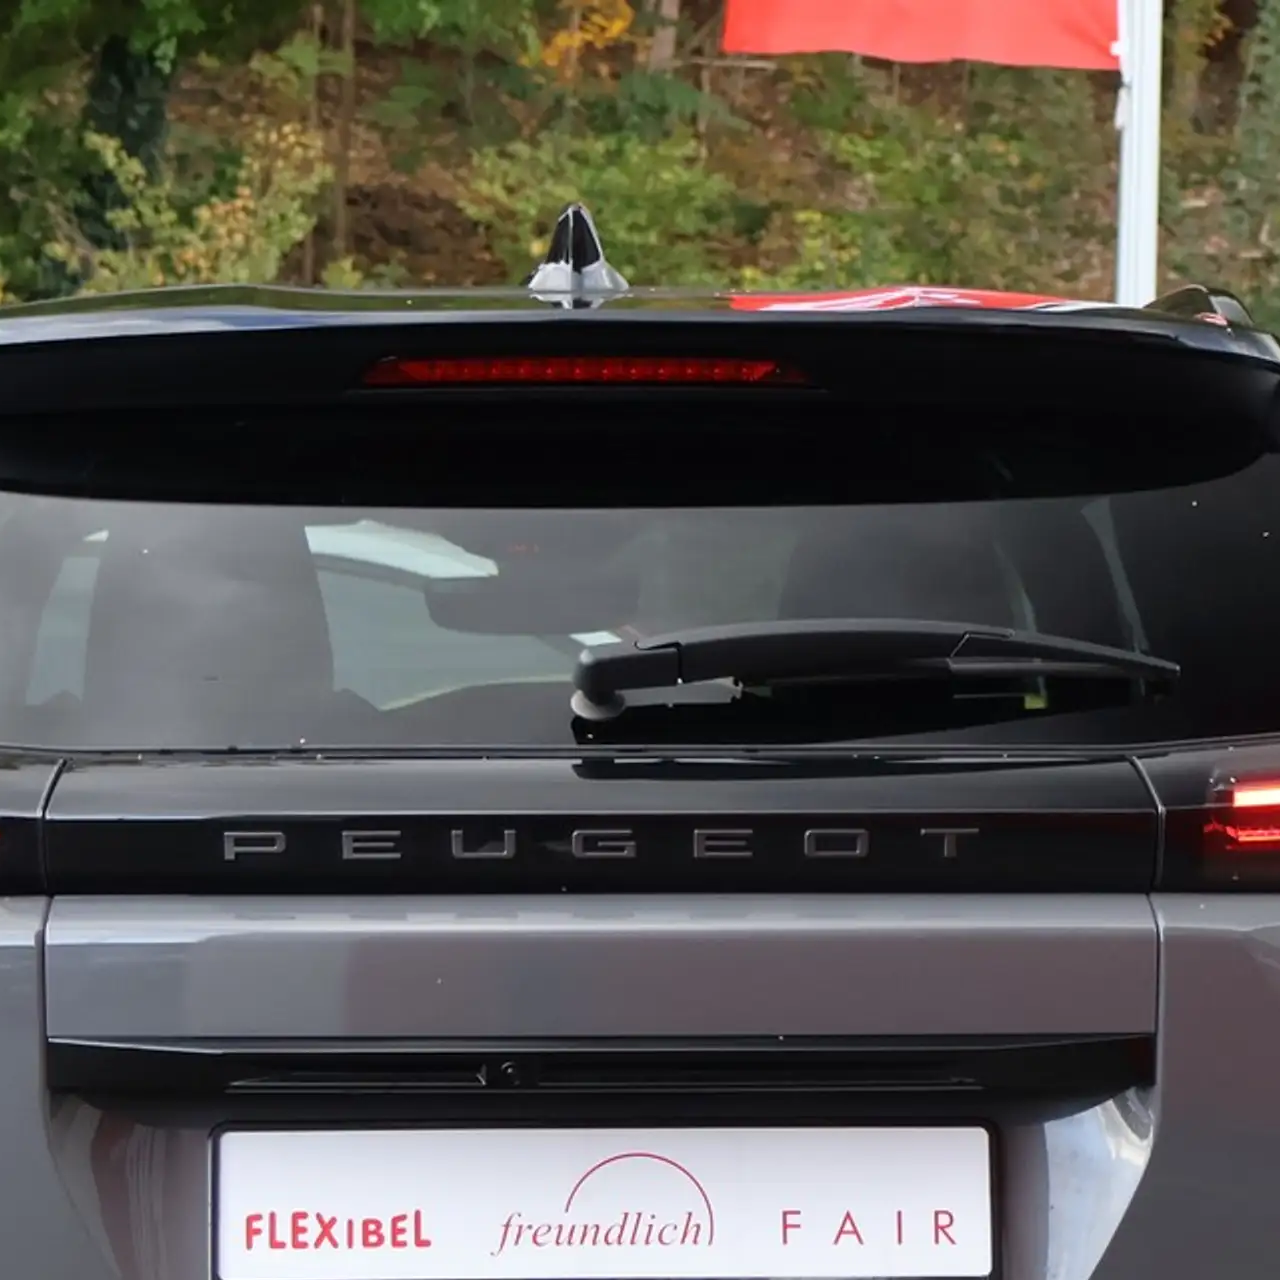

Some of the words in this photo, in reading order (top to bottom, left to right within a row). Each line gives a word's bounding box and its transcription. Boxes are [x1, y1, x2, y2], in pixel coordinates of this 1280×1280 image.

[223, 827, 980, 861] PEUGEOT
[245, 1210, 432, 1250] FLEXIBEL
[490, 1211, 704, 1256] freundlich
[781, 1209, 957, 1246] FAIR
